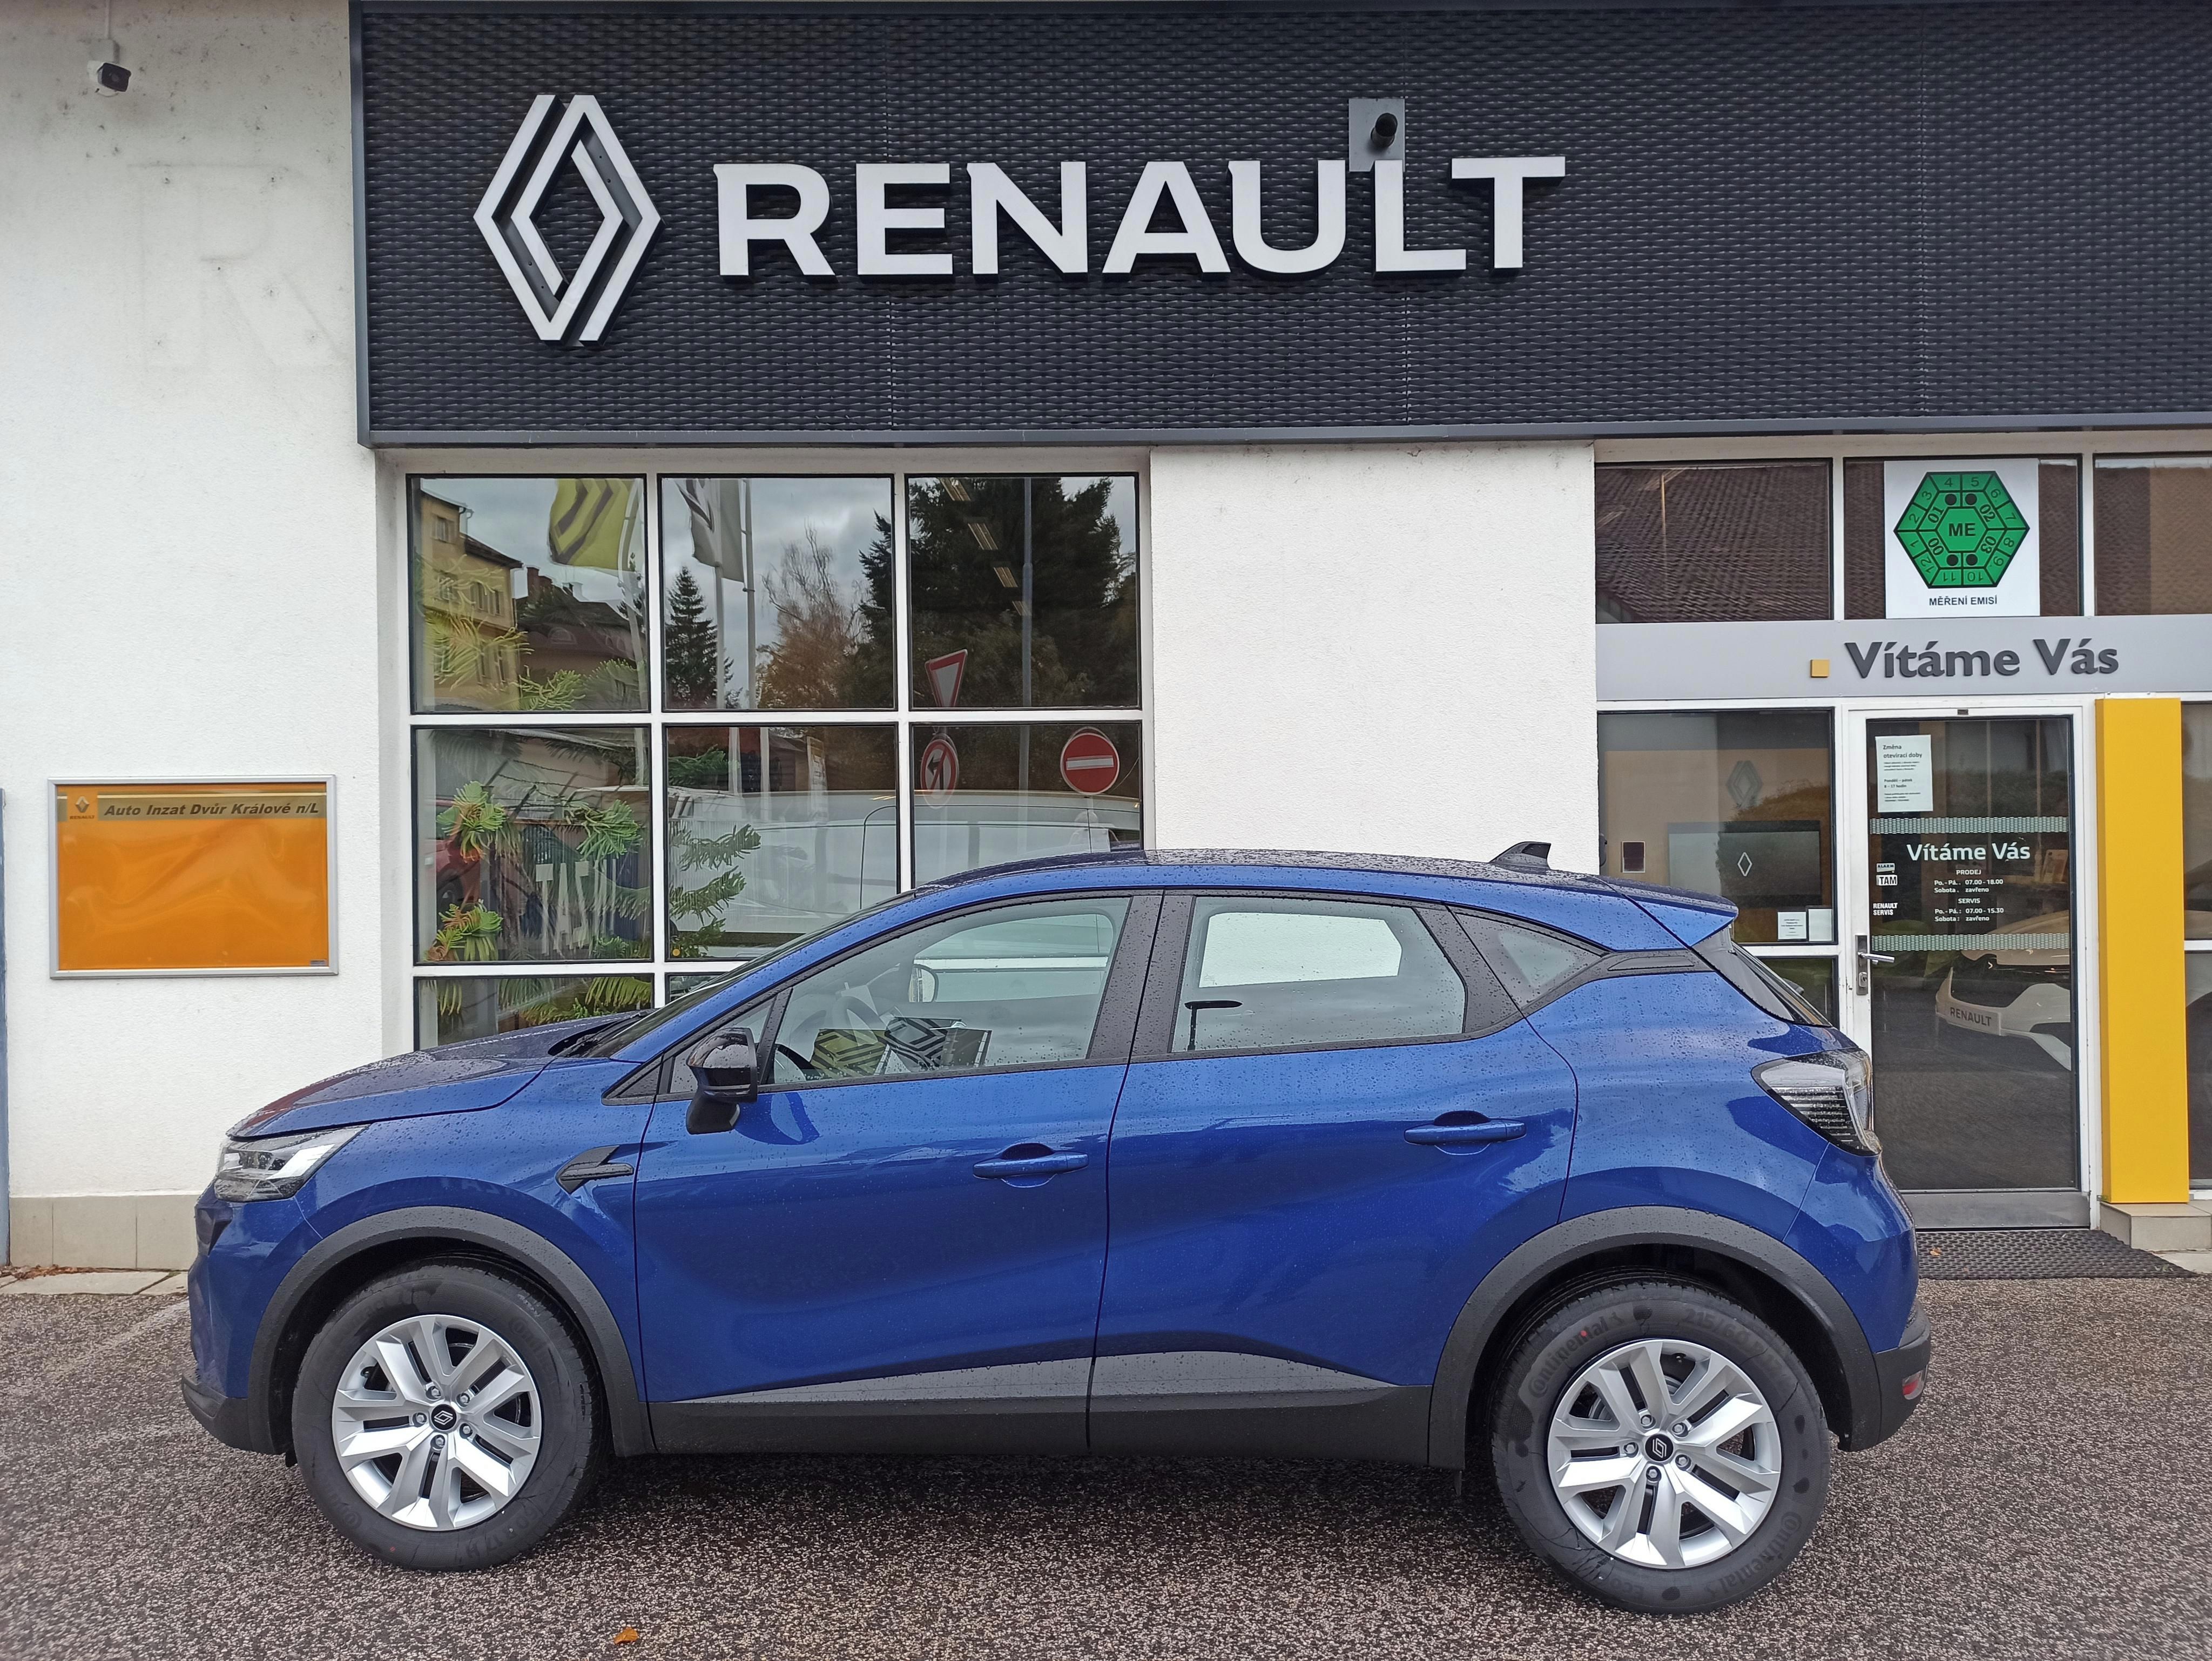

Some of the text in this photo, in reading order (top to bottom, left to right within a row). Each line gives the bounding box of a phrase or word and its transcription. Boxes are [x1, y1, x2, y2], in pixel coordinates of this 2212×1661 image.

[713, 156, 1566, 278] RENAULT
[1944, 477, 1953, 487] 4
[1971, 477, 1979, 487] 5
[1921, 491, 1932, 501] 3
[1908, 513, 1920, 524] 2
[1927, 507, 1944, 523] 01
[1979, 504, 1995, 522] 02
[2005, 512, 2017, 521] 7
[1948, 523, 1976, 537] ME
[1928, 537, 1944, 556] 00
[1980, 536, 1997, 553] 03
[2003, 537, 2014, 548] 8
[1920, 556, 1935, 573] 12
[1943, 572, 1956, 582] 11
[1967, 571, 1983, 582] 10
[1929, 595, 1997, 606] MĚŘENÍ EMISÍ
[1844, 638, 2119, 678] Vítáme Vás
[104, 802, 319, 816] Auto Inzat Dvůr Králové n/L
[1906, 842, 2031, 861] Vítáme Vás
[1879, 876, 1897, 884] TAM
[1950, 1007, 1992, 1027] RENAULT
